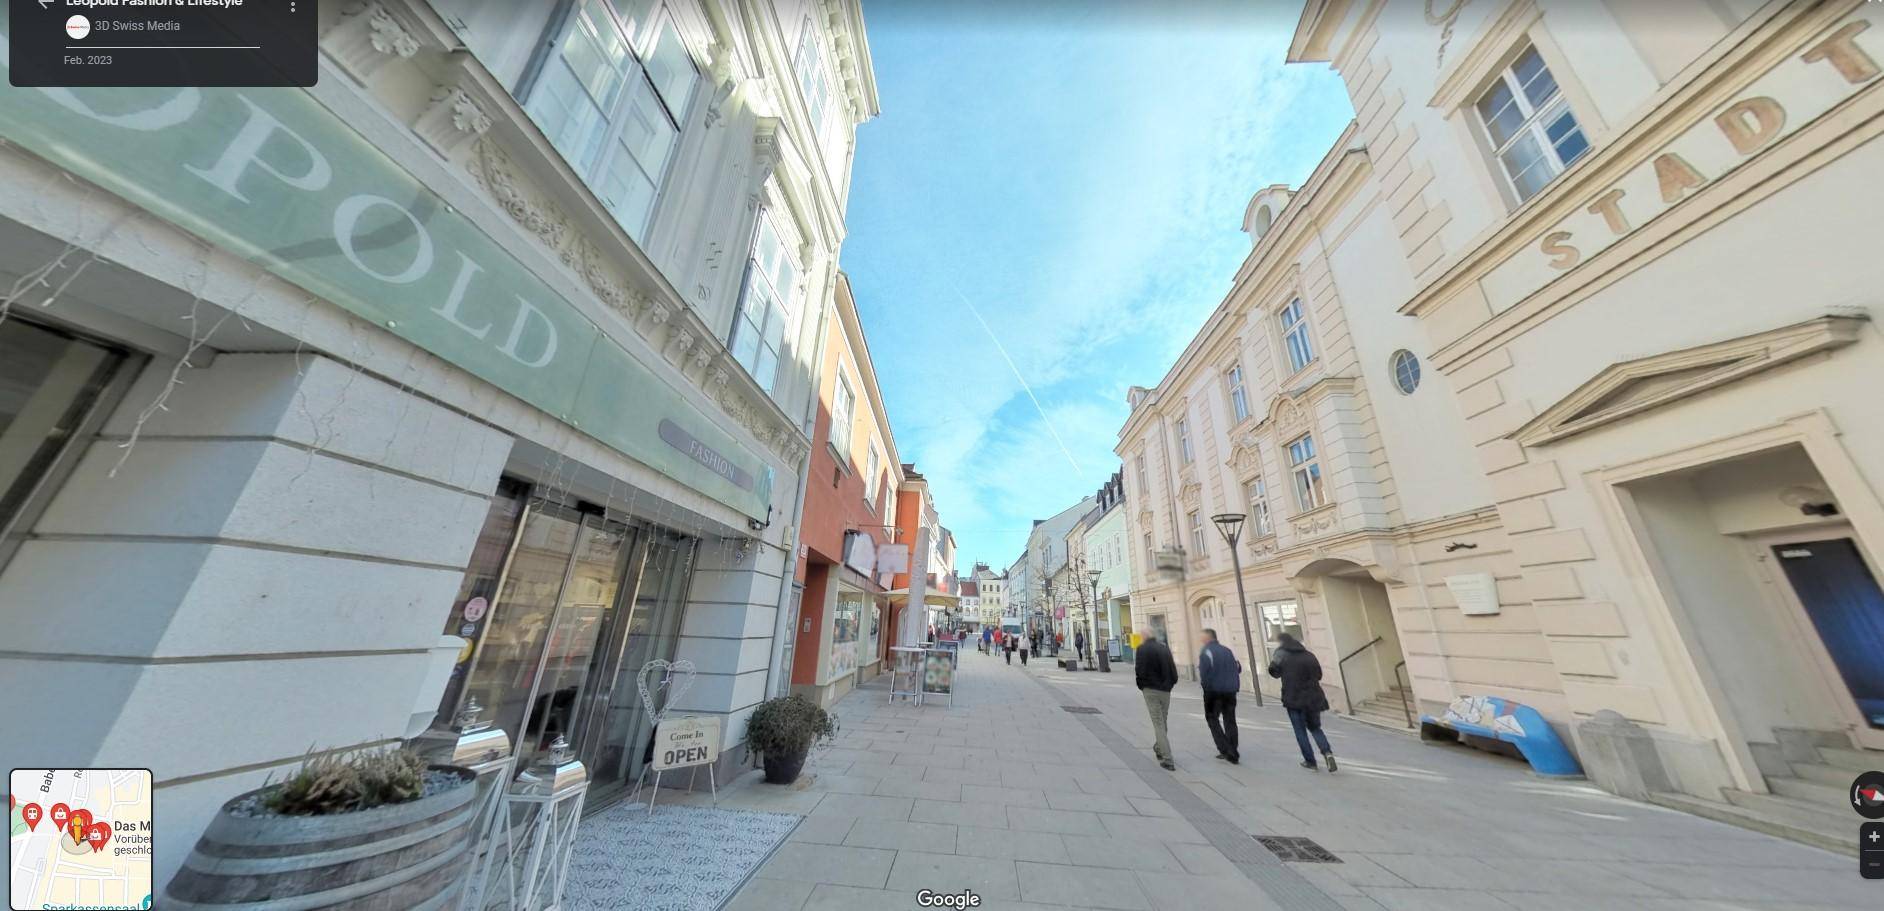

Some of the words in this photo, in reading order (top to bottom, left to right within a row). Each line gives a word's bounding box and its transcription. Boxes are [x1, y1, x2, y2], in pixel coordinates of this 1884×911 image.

[1540, 19, 1882, 270] STADT
[689, 439, 735, 479] FASHION
[670, 732, 694, 741] Come
[664, 746, 708, 765] OPEN
